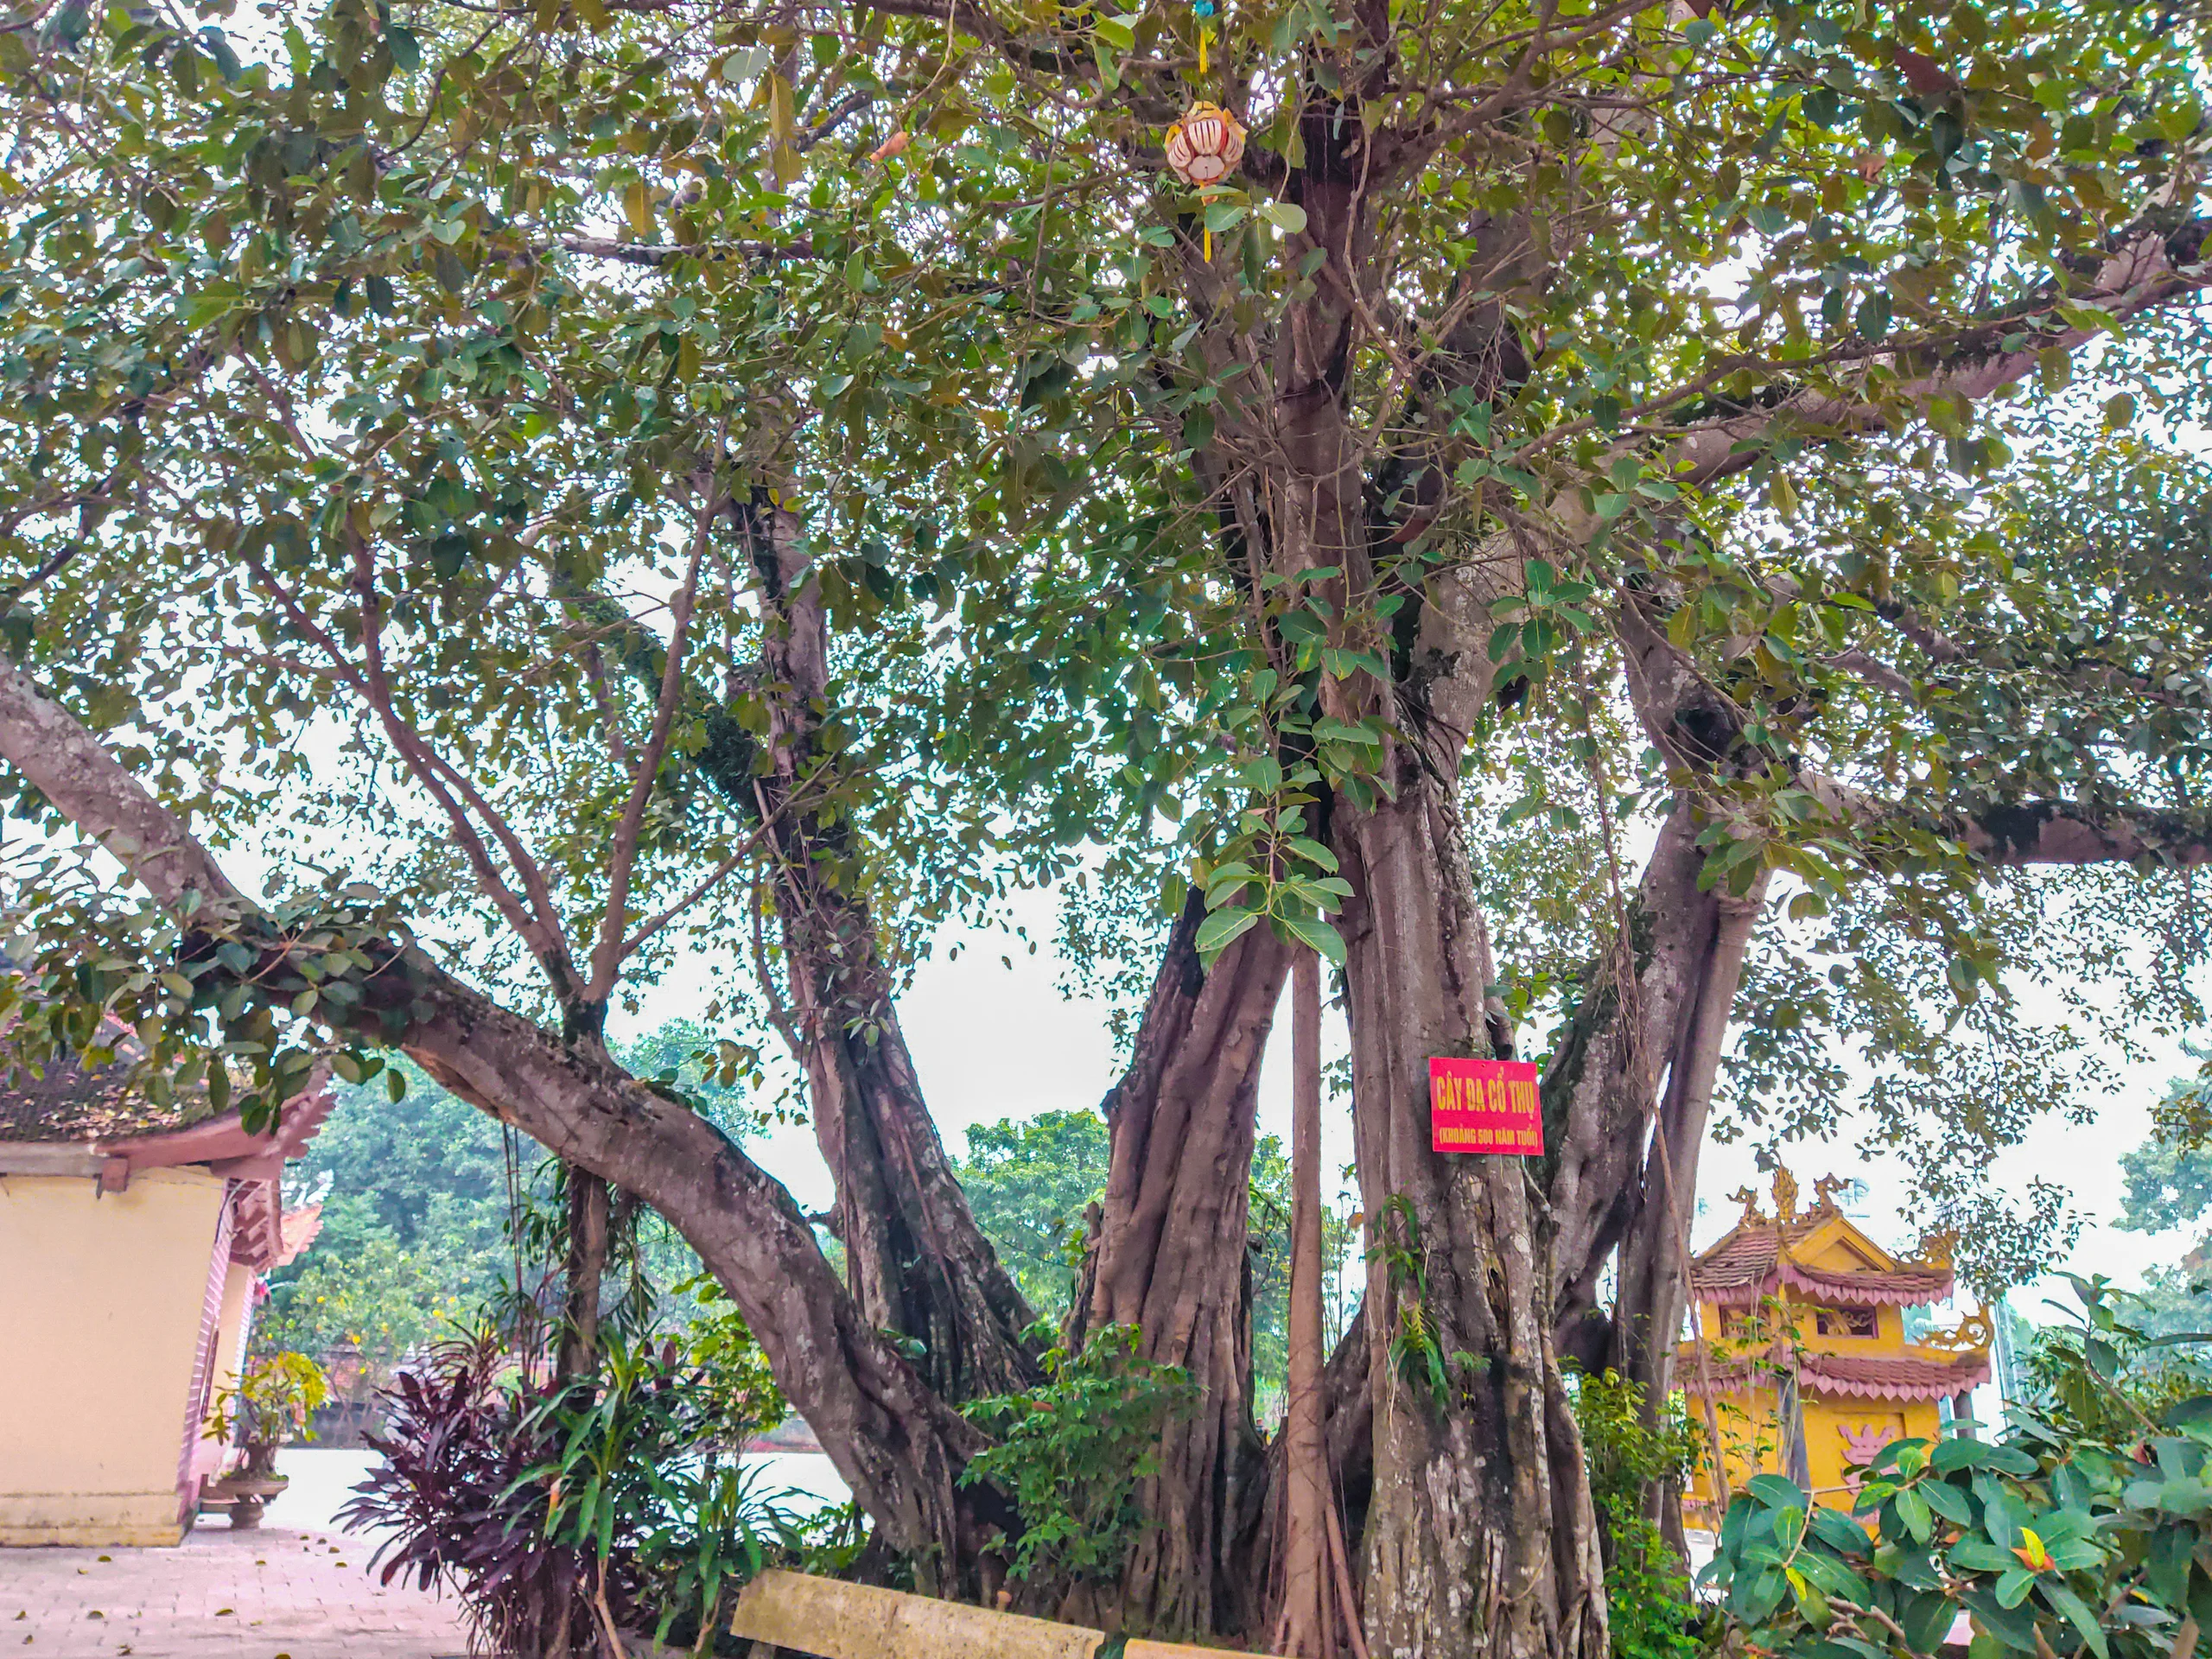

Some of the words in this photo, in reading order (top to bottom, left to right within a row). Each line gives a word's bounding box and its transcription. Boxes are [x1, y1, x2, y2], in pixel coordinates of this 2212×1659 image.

[1436, 1071, 1462, 1111] CÂY
[1465, 1077, 1486, 1112] ĐA
[1487, 1065, 1506, 1113] CỔ
[1508, 1080, 1535, 1121] THỤ
[1478, 1128, 1493, 1145] 500
